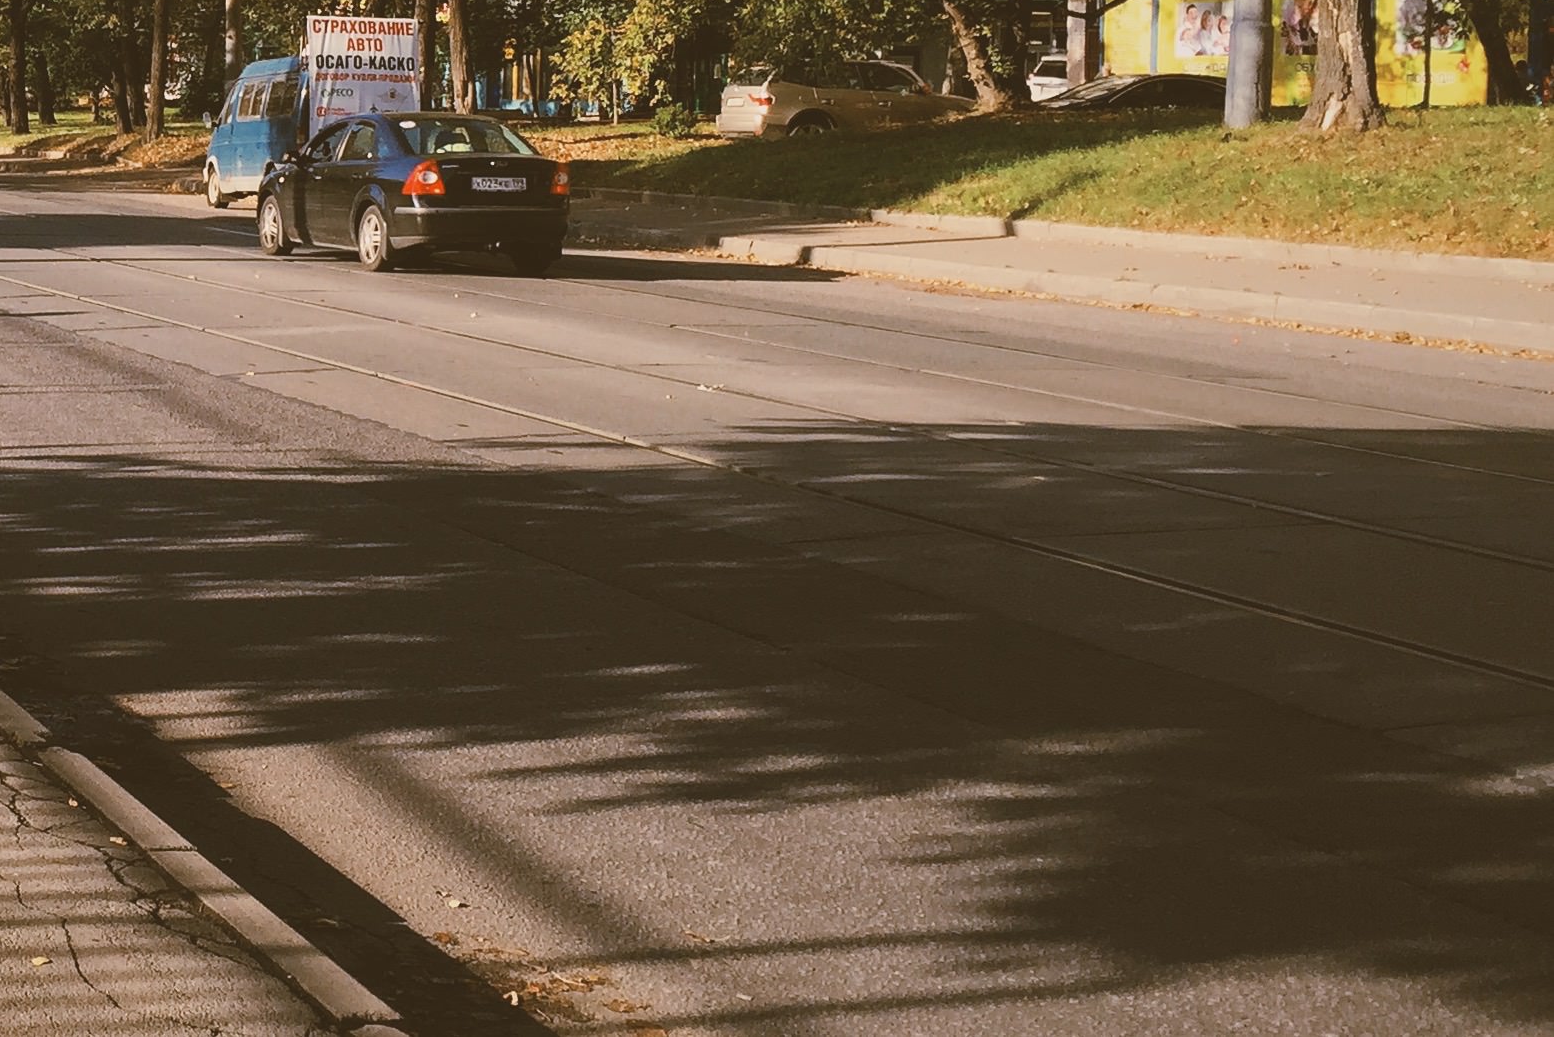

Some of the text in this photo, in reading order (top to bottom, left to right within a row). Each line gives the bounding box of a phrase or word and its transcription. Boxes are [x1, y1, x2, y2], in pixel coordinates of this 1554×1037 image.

[312, 19, 414, 36] СТРАХОВАНИЕ
[346, 38, 383, 52] АВТО
[315, 54, 415, 72] ОСАГО-КАСКО
